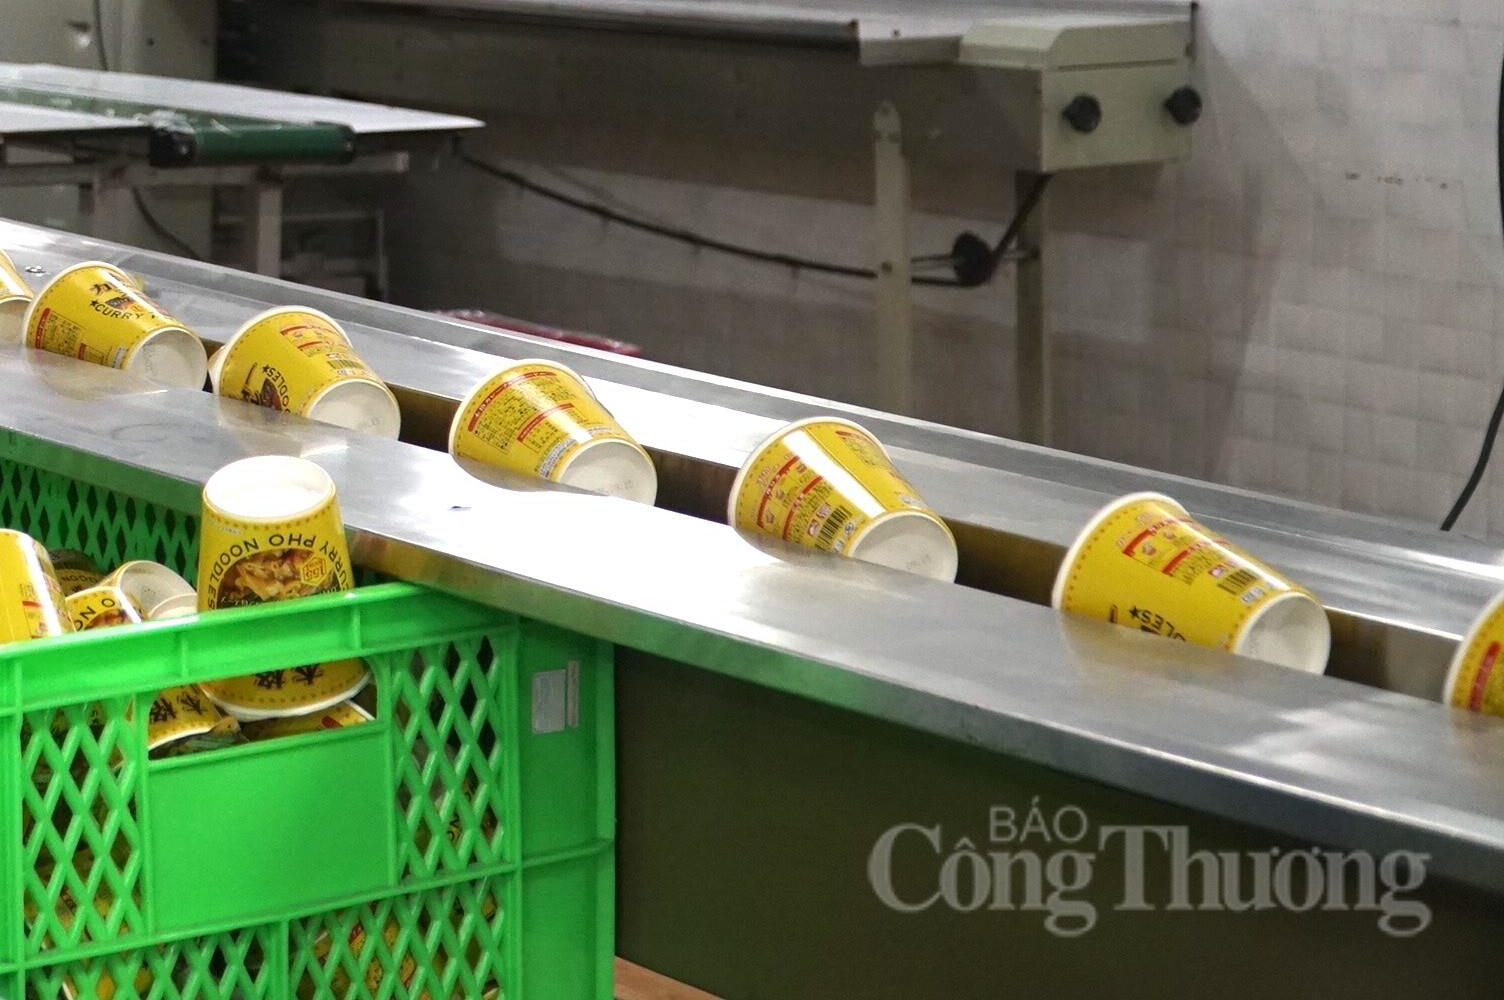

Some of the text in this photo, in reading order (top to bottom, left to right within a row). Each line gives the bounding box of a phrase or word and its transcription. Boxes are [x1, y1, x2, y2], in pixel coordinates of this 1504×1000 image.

[207, 533, 349, 609] URRY PHO NOODLES
